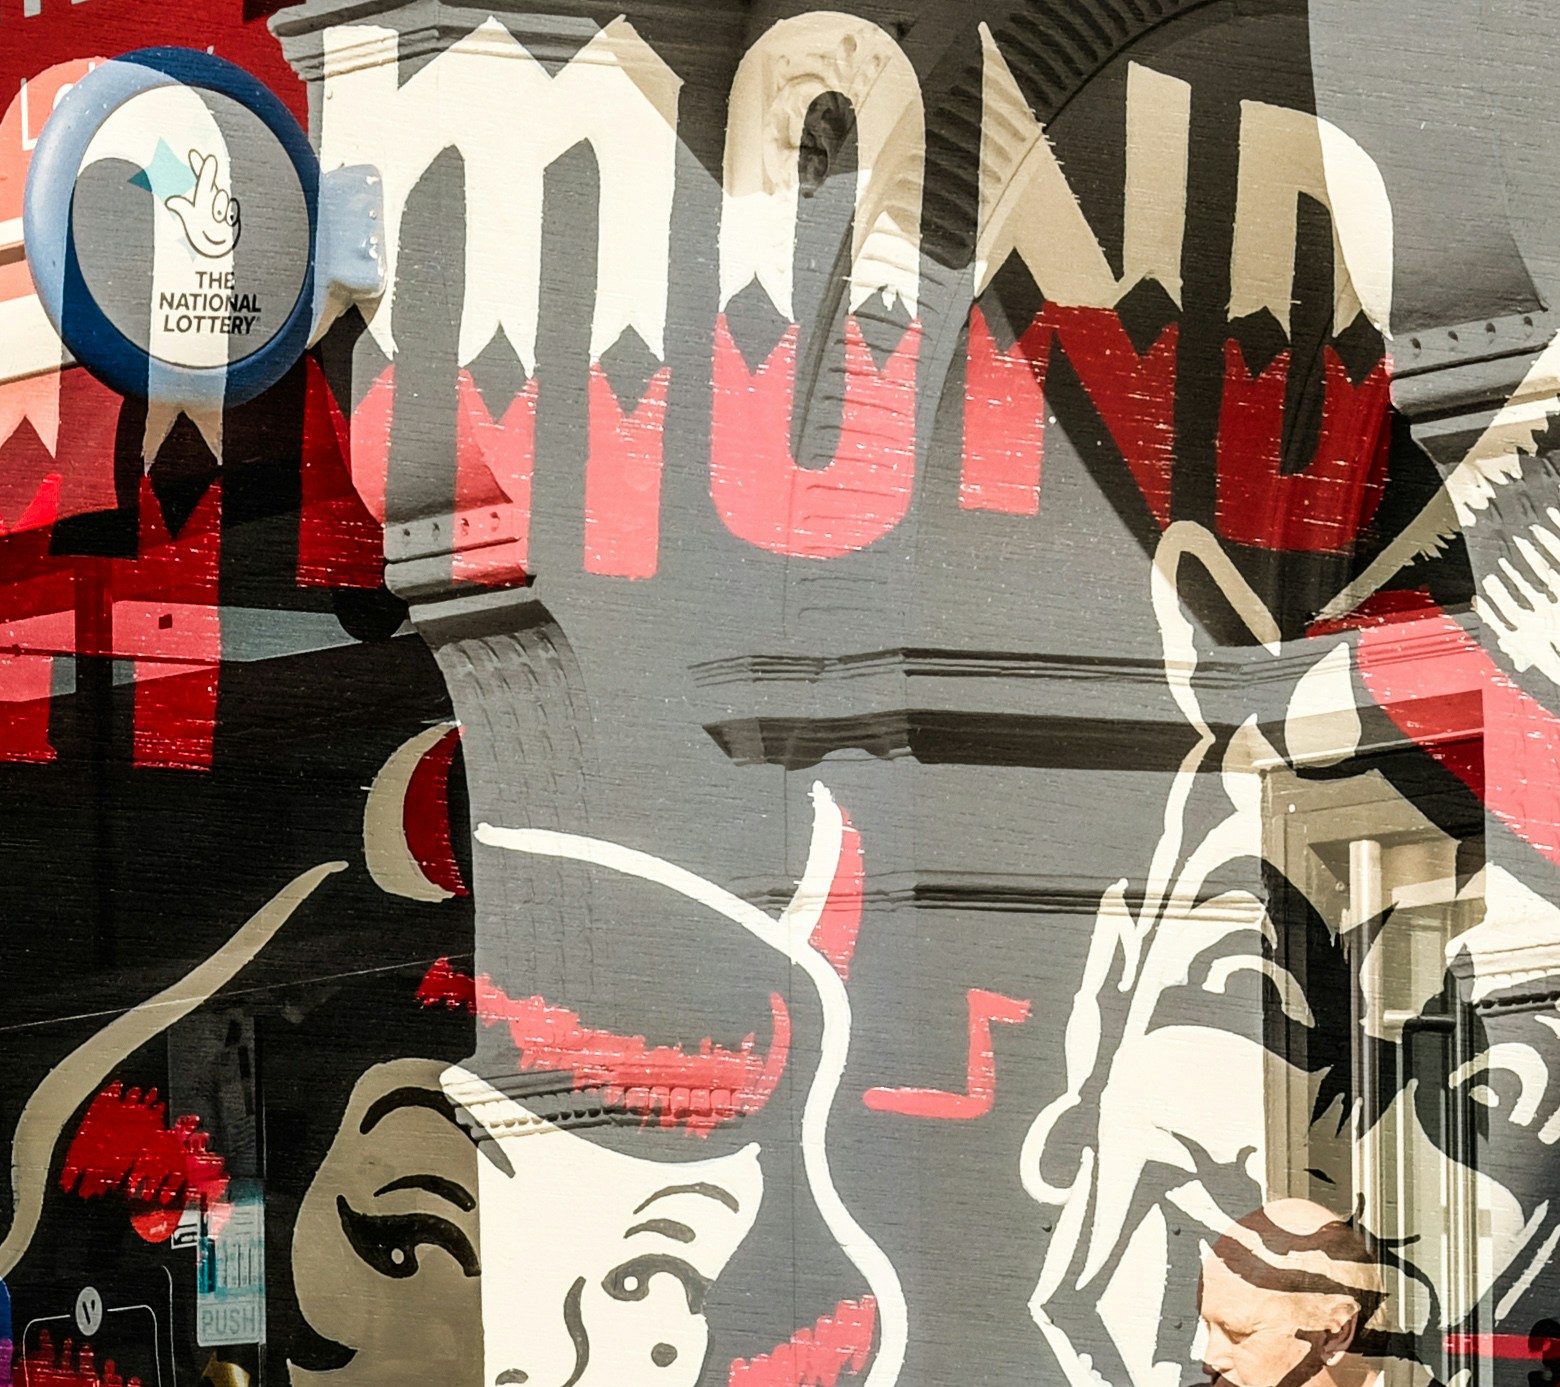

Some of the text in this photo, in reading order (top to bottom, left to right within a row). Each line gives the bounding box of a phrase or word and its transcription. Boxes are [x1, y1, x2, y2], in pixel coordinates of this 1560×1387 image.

[195, 271, 236, 290] THE
[159, 291, 262, 313] NATIONAL
[163, 314, 255, 335] LOTTERY
[201, 1307, 256, 1335] PUSH
